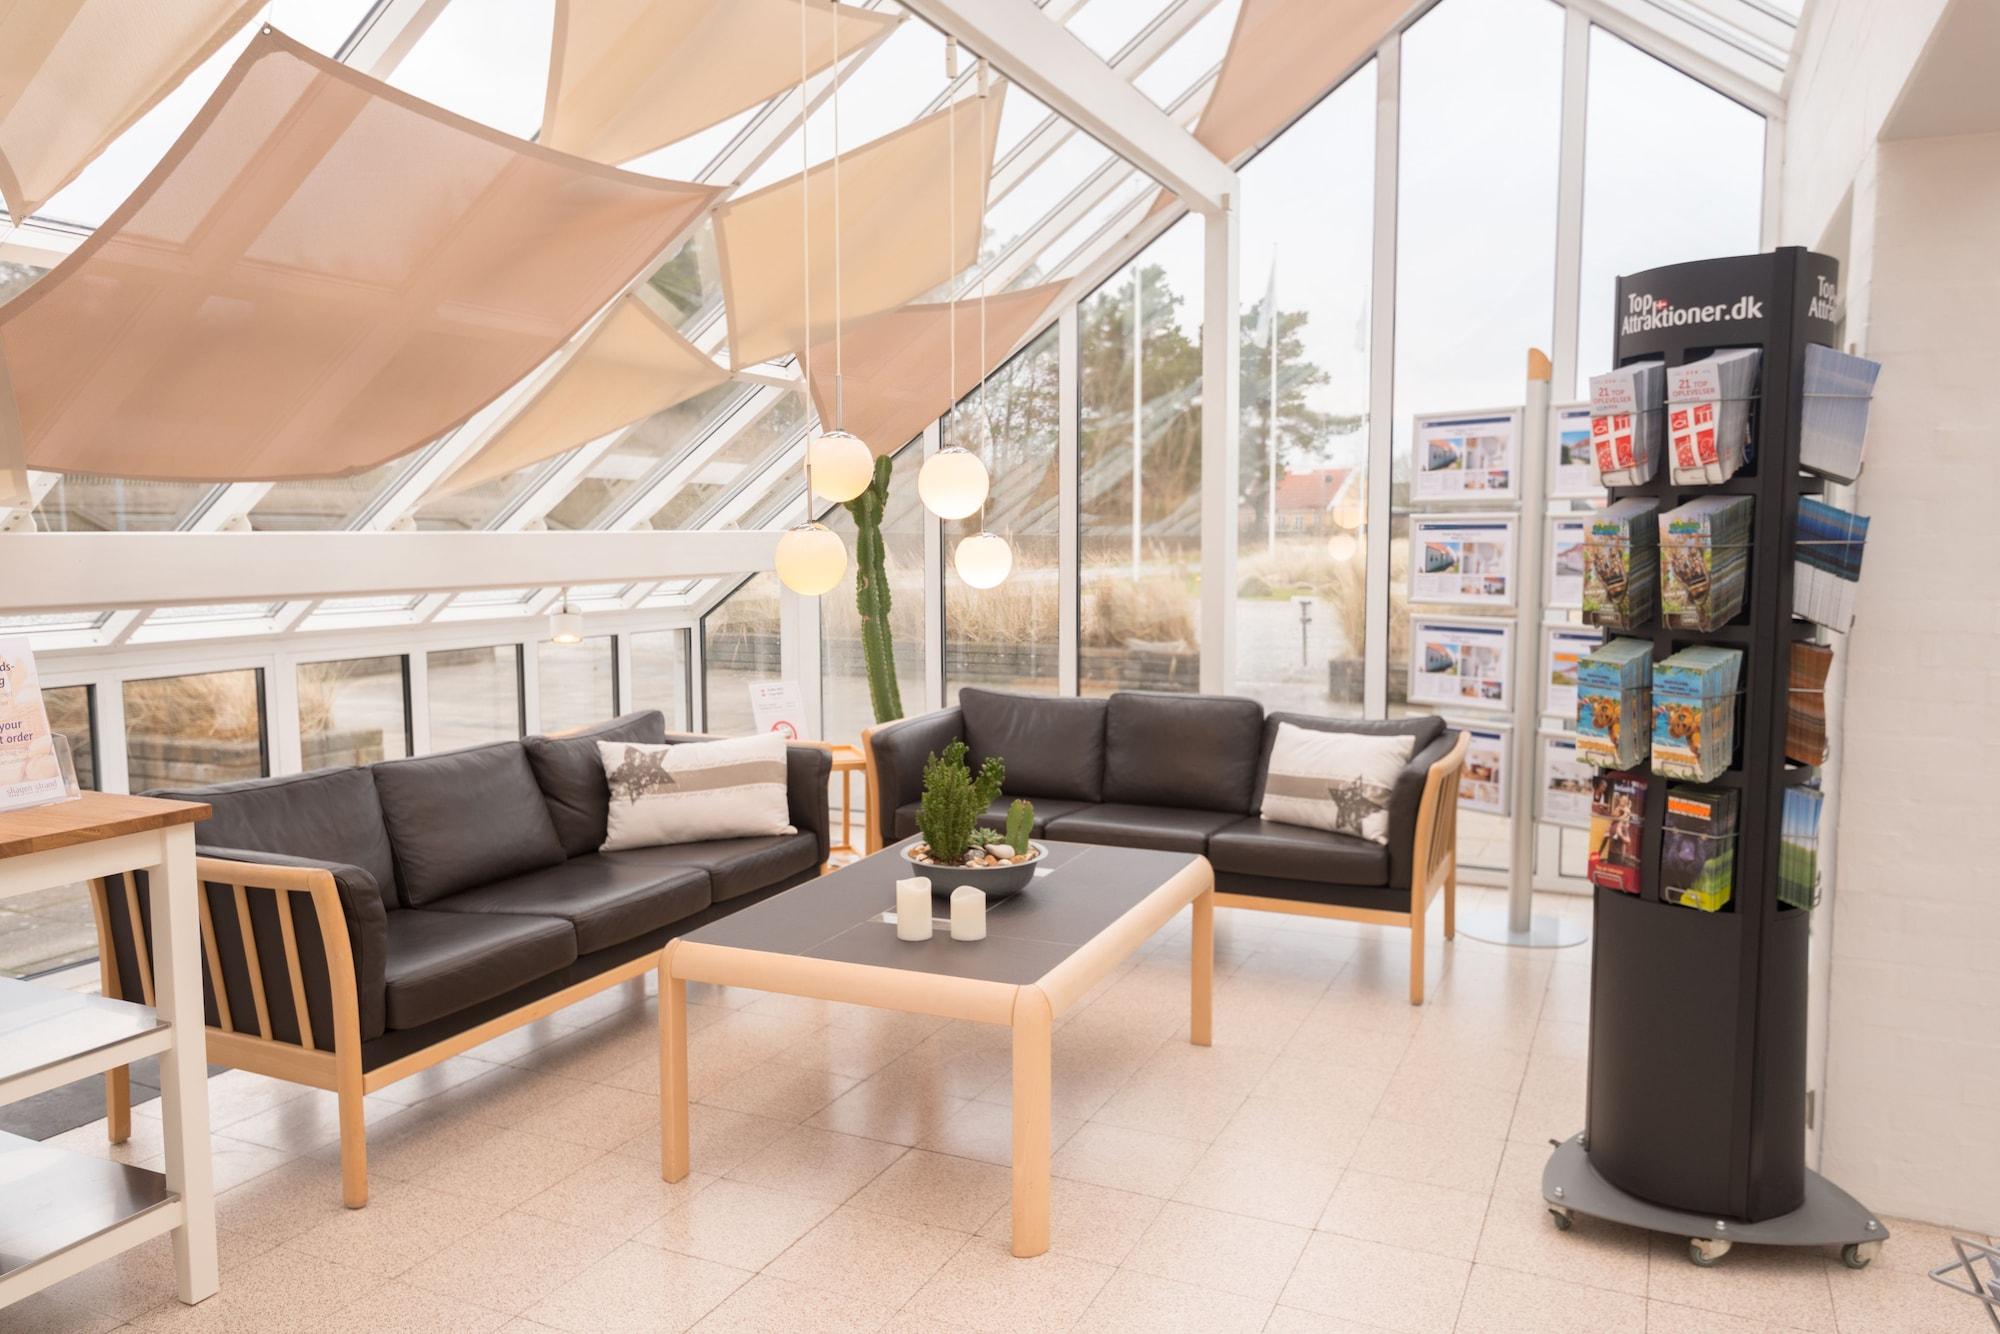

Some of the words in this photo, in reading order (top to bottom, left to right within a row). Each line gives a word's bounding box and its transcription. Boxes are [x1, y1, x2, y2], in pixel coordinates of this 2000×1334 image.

[1627, 292, 1653, 316] Top
[1621, 295, 1764, 336] Attraktioner.dk
[1679, 379, 1690, 389] 21
[1598, 387, 1609, 397] 21
[0, 721, 22, 733] your
[7, 732, 33, 744] order
